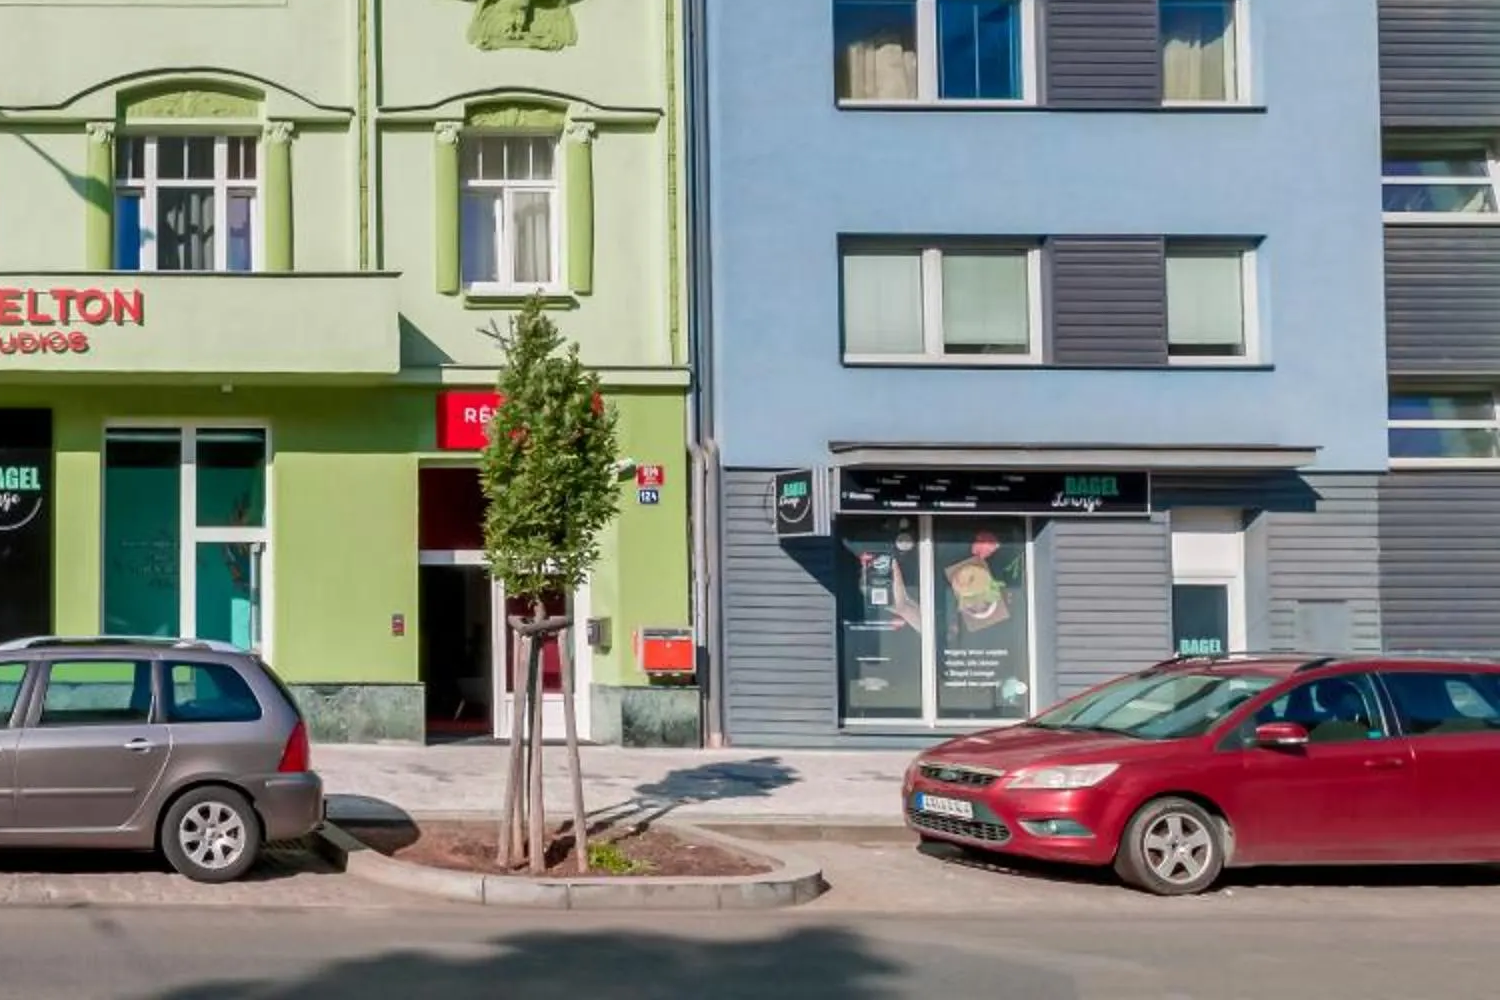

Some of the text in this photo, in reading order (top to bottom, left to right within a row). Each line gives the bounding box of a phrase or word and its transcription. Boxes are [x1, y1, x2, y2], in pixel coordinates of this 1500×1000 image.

[1065, 476, 1119, 496] BAGEL
[1051, 491, 1102, 513] Lounge
[1180, 638, 1221, 655] BAGEL
